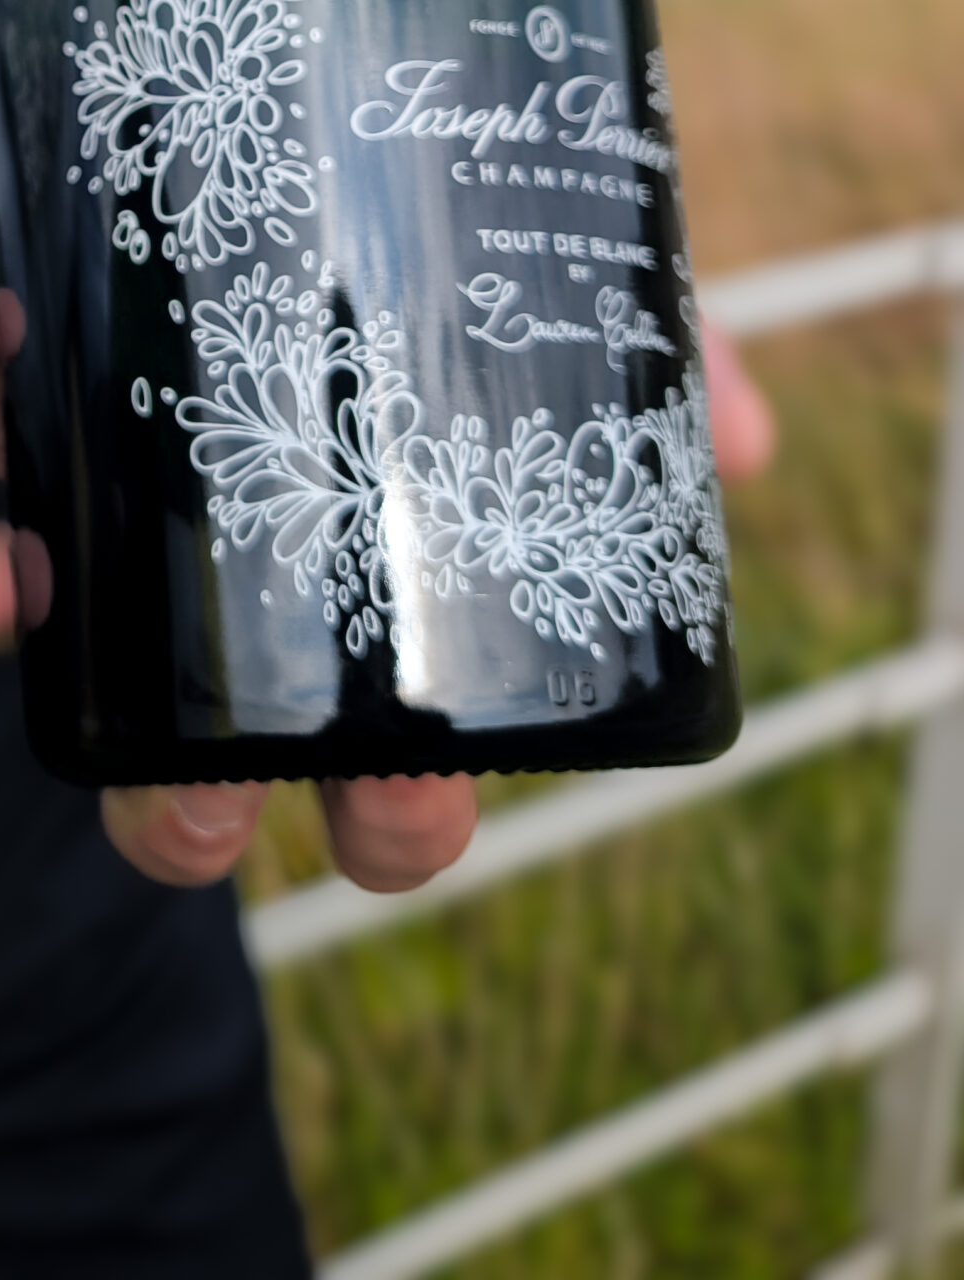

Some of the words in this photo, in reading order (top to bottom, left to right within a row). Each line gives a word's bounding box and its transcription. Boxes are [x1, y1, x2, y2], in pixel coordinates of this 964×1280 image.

[349, 57, 554, 160] Joseph
[450, 160, 656, 209] CHAMPAGNE
[475, 228, 550, 256] TOUT
[553, 232, 588, 259] DE
[589, 236, 659, 271] BLANC
